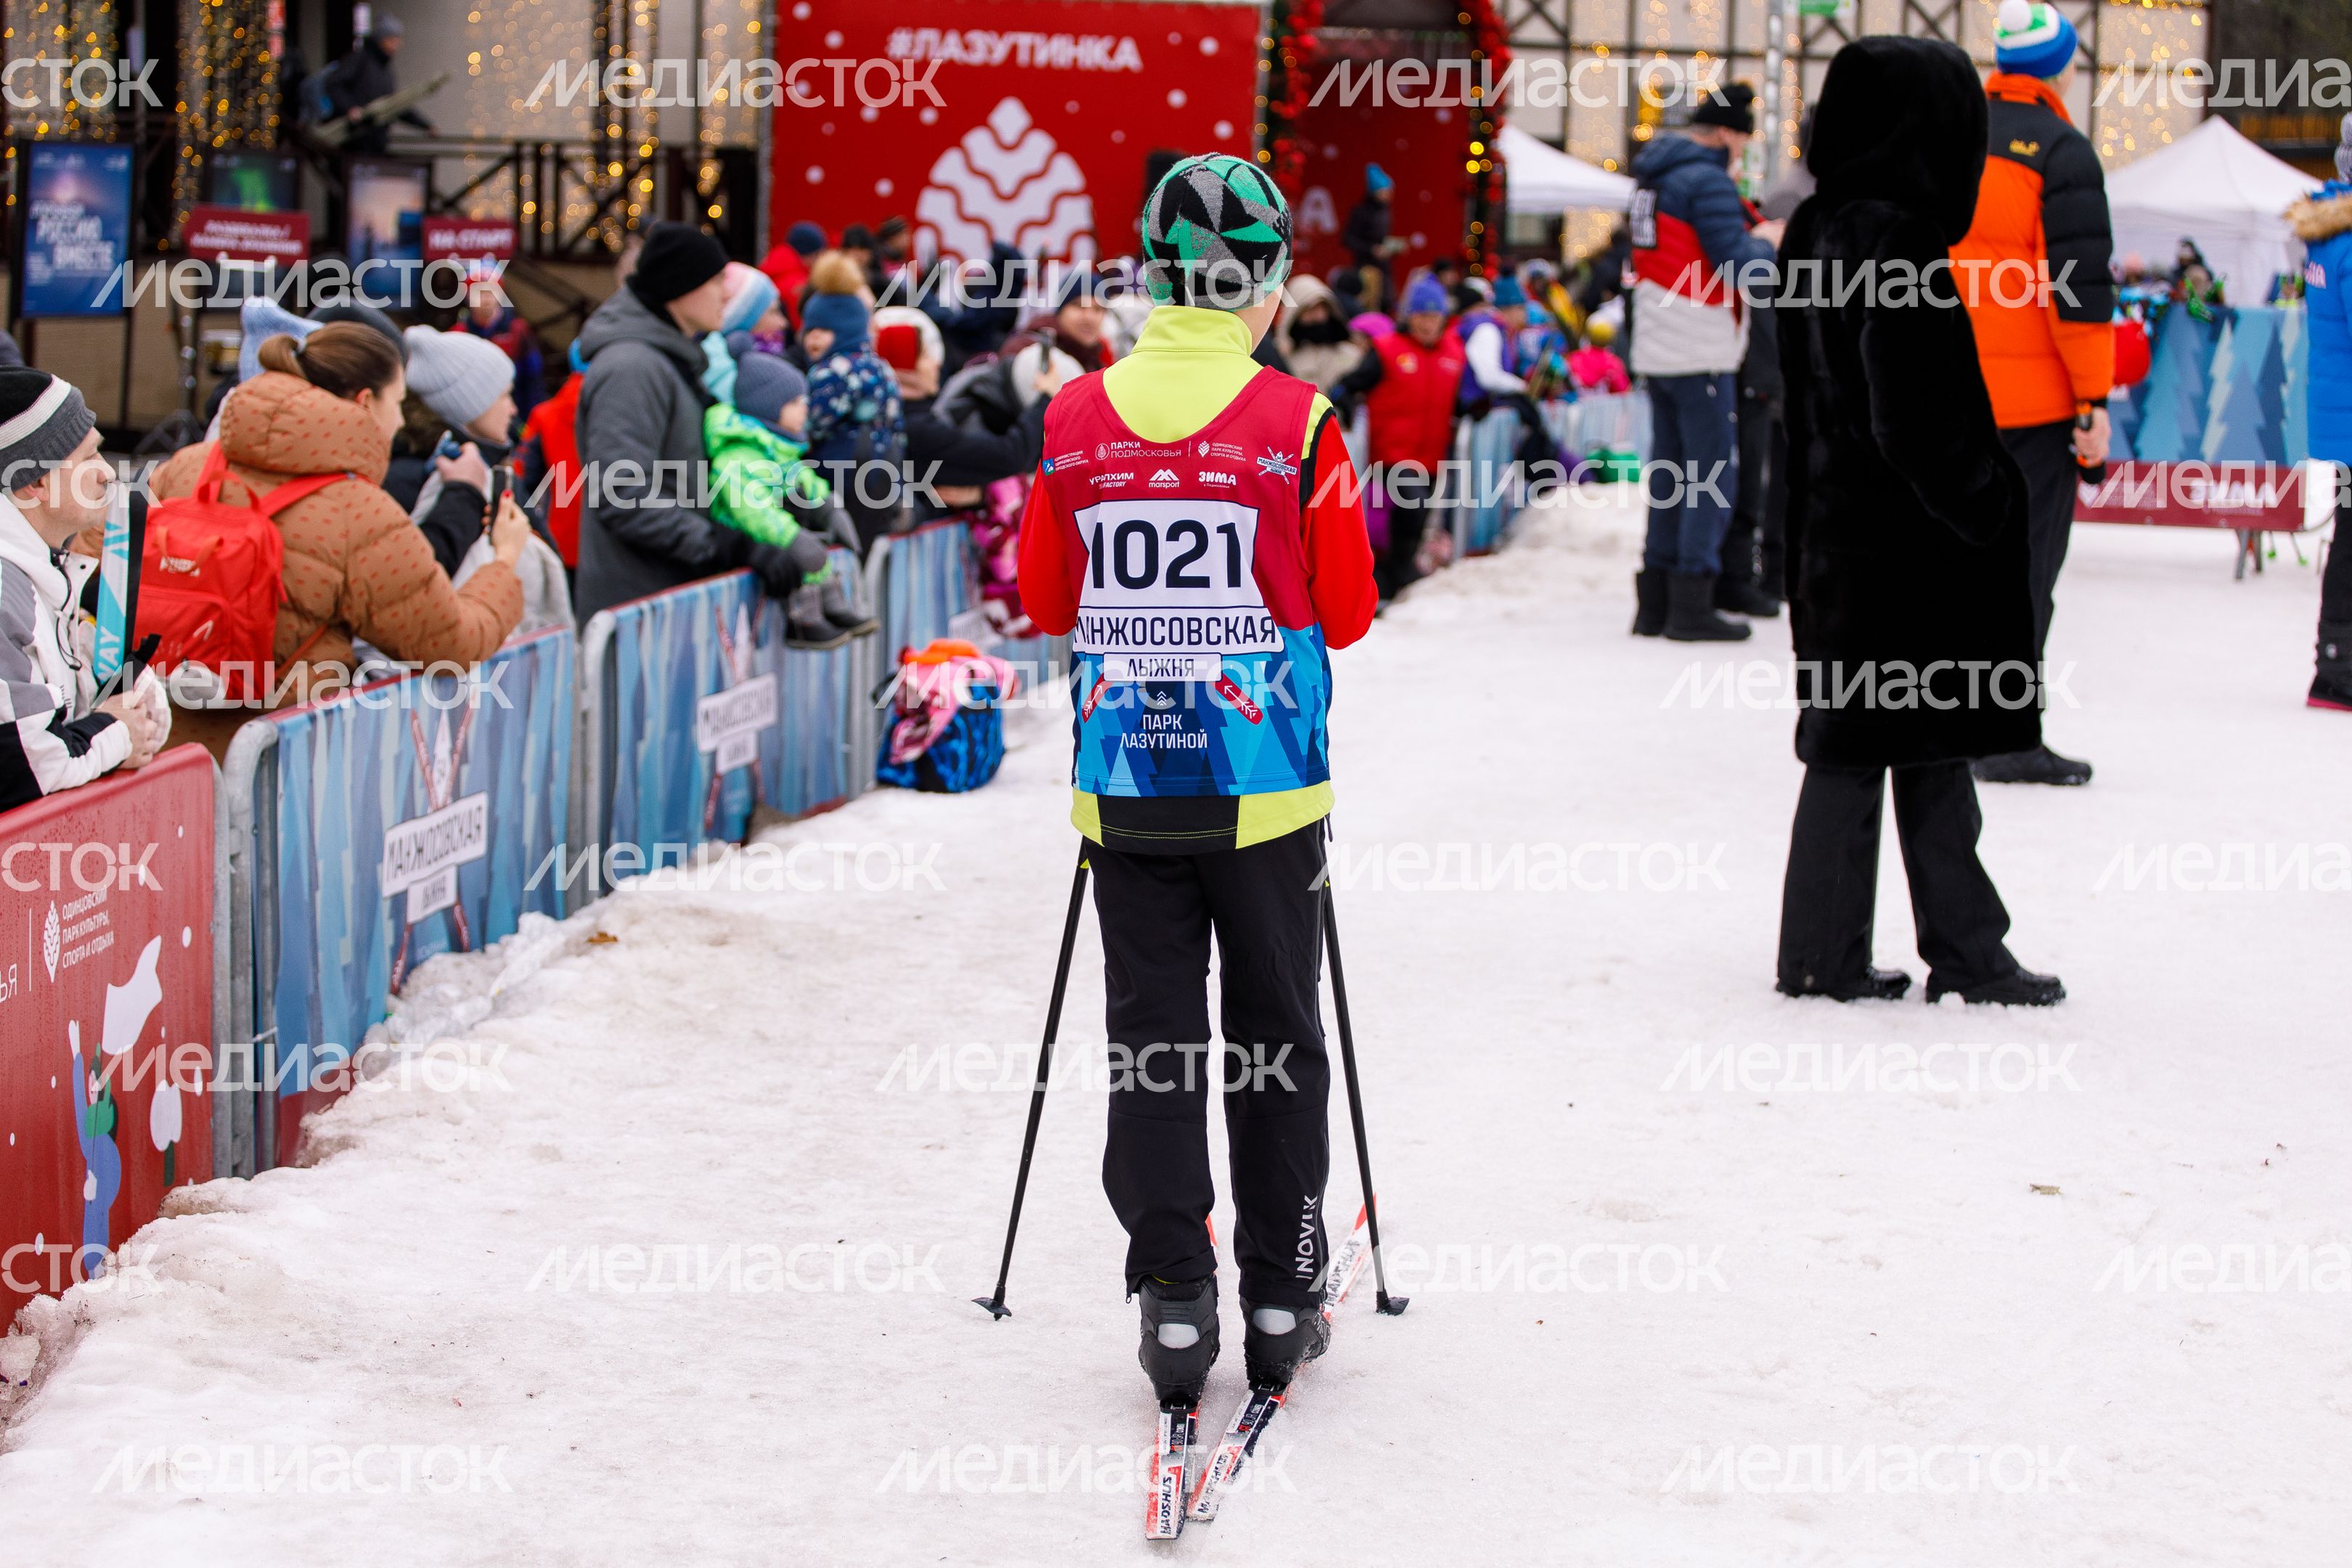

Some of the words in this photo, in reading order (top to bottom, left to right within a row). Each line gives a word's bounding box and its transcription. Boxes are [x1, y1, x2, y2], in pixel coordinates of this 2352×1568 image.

[887, 27, 1143, 71] #ЛАЗУТИНКА
[1111, 449, 1182, 459] ПОДМОСКОВЬЯ
[1257, 457, 1296, 474] МАНЖОСОВСКАЯ
[1089, 472, 1134, 486] УРАЛХИМ
[1199, 471, 1237, 486] ЗИМА
[1092, 520, 1241, 589] 1021
[1127, 658, 1195, 677] ЛЫЖНЯ
[1143, 714, 1183, 730] ПАРК
[1120, 729, 1208, 748] ЛАЗУТИНОЙ
[385, 804, 482, 883] МАНЖОСОВСКАЯ
[62, 883, 107, 922] ОДИНЦОВСКИЙ
[62, 925, 79, 944] ПАРК
[62, 945, 86, 969] СПОРТА
[86, 942, 91, 957] И
[1295, 1194, 1318, 1281] INOVIK
